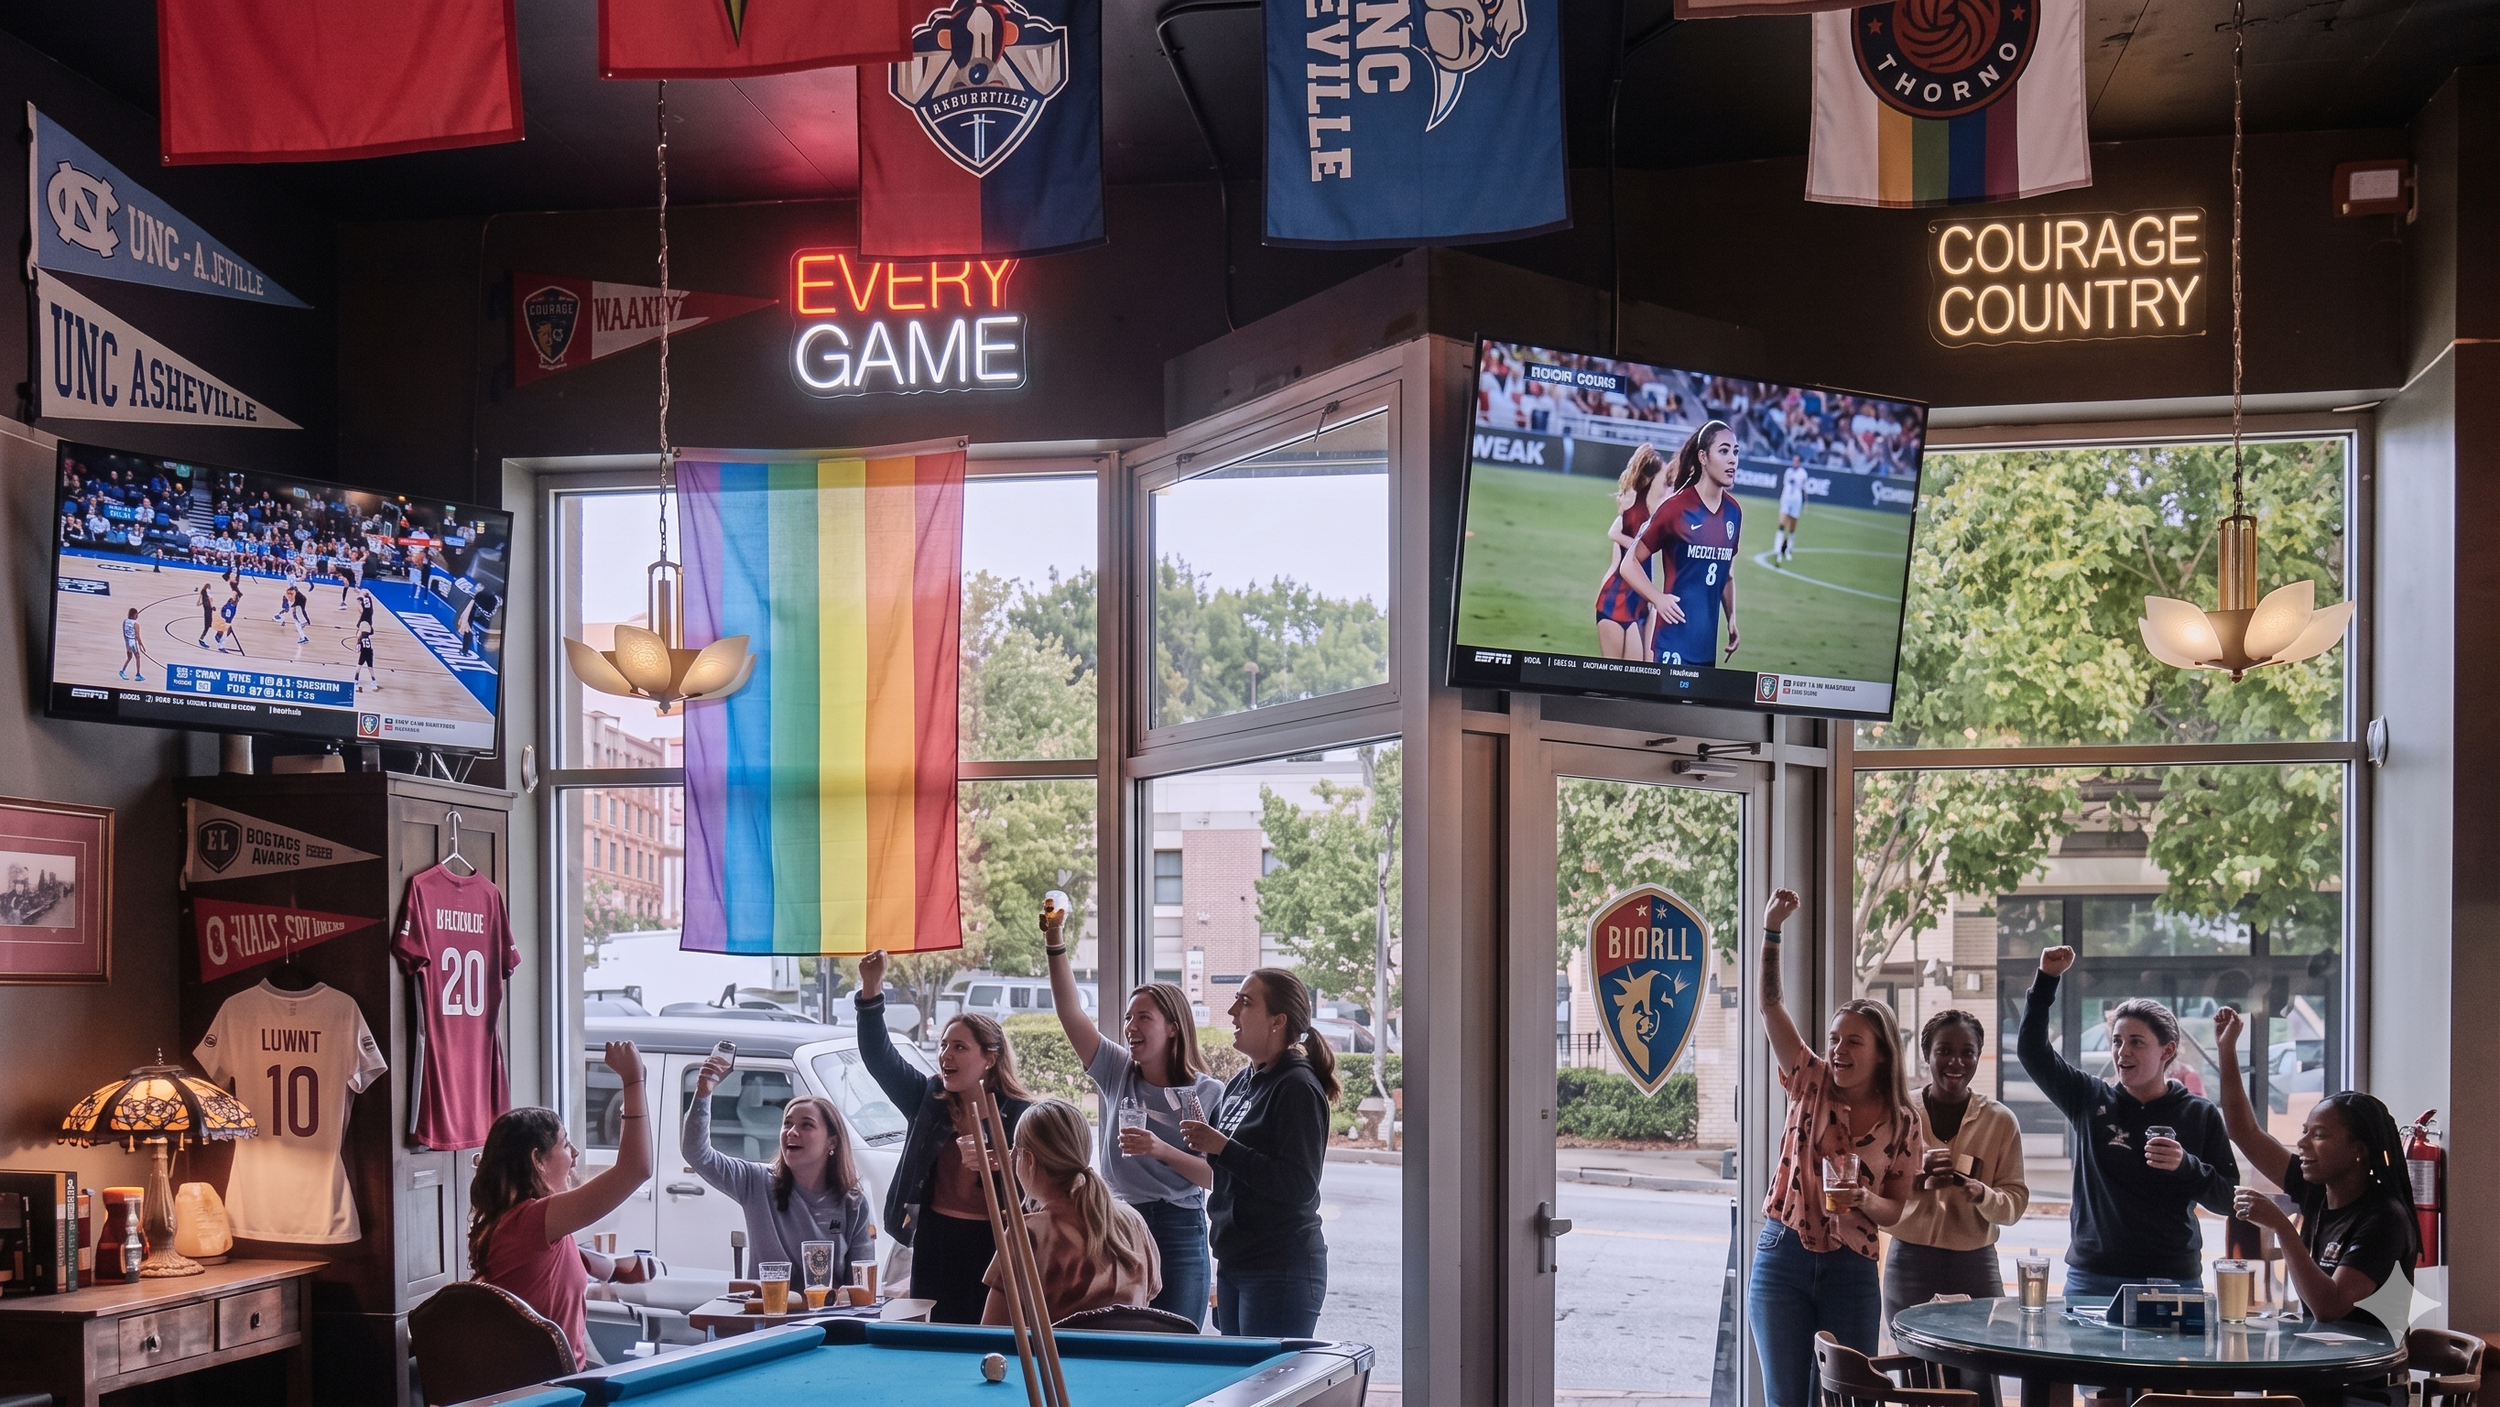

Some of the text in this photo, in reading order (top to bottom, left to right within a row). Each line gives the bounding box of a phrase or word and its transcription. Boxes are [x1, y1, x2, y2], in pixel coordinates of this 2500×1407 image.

[1877, 42, 2017, 102] THORNO
[1938, 215, 2201, 275] COURAGE
[529, 303, 574, 316] COURAGE
[798, 253, 1010, 314] EVERY
[1938, 275, 2200, 336] COUNTRY
[50, 301, 257, 422] UNC ASHEVILLE
[796, 316, 1018, 388] GAME
[1705, 562, 1718, 586] 8
[252, 847, 300, 866] AVARKS
[441, 946, 485, 1017] 20
[261, 1028, 322, 1054] LUWNT
[266, 1064, 319, 1138] 10
